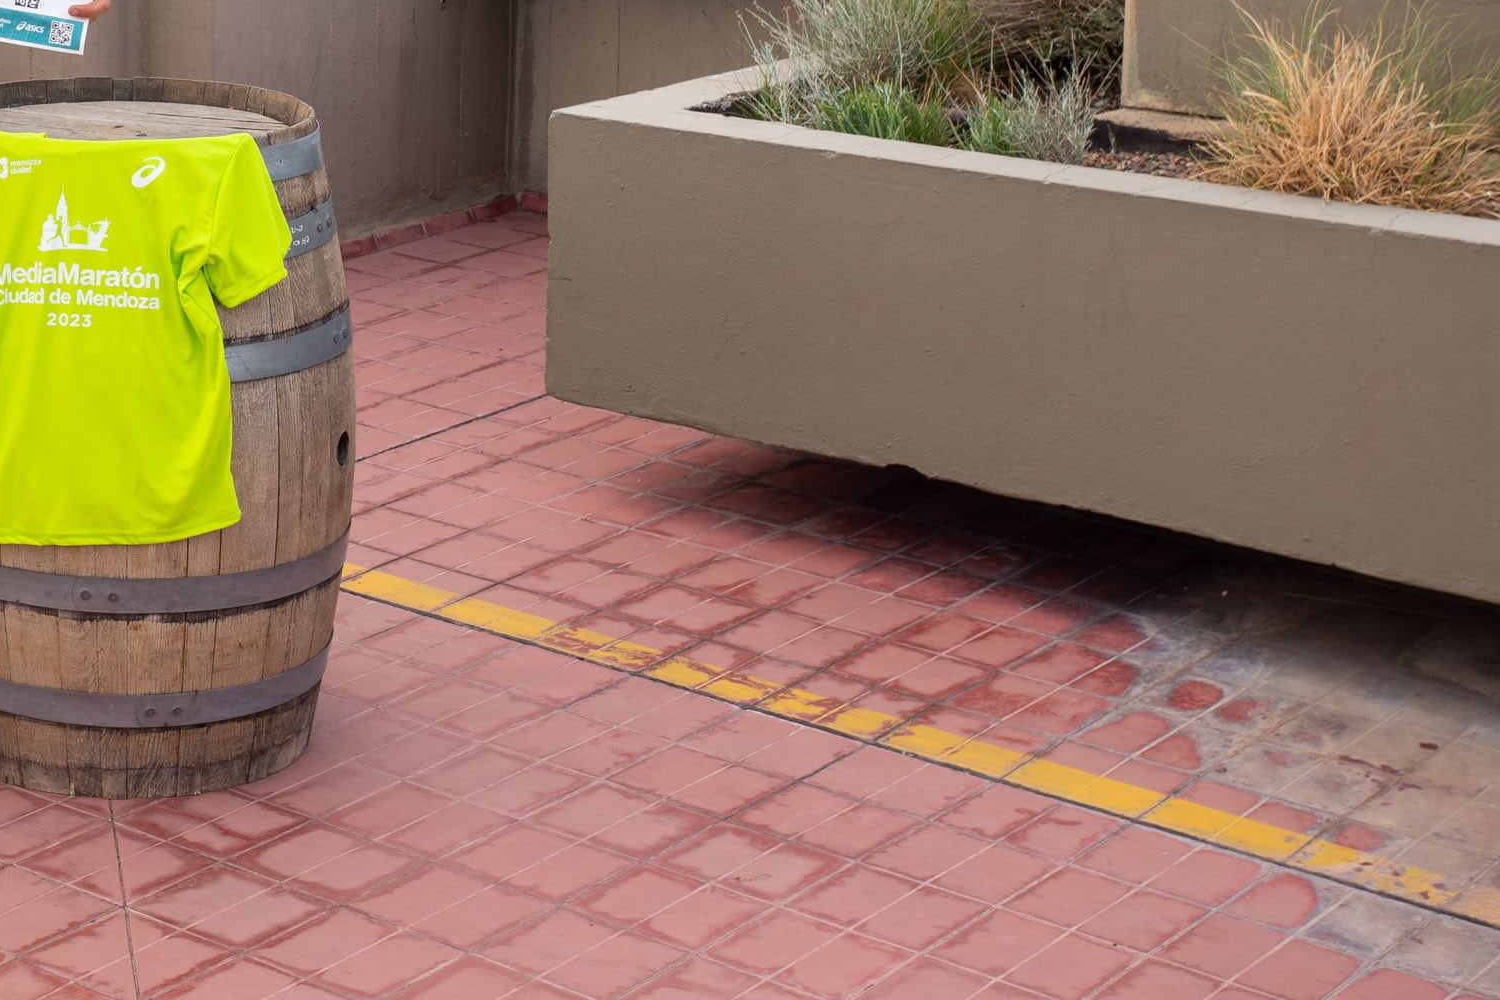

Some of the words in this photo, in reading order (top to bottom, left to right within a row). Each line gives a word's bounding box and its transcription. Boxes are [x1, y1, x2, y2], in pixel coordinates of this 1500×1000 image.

[10, 159, 42, 167] mendoza
[10, 165, 32, 175] ciudad
[49, 289, 71, 305] de
[76, 289, 160, 310] Mendoza
[47, 312, 92, 328] 2023
